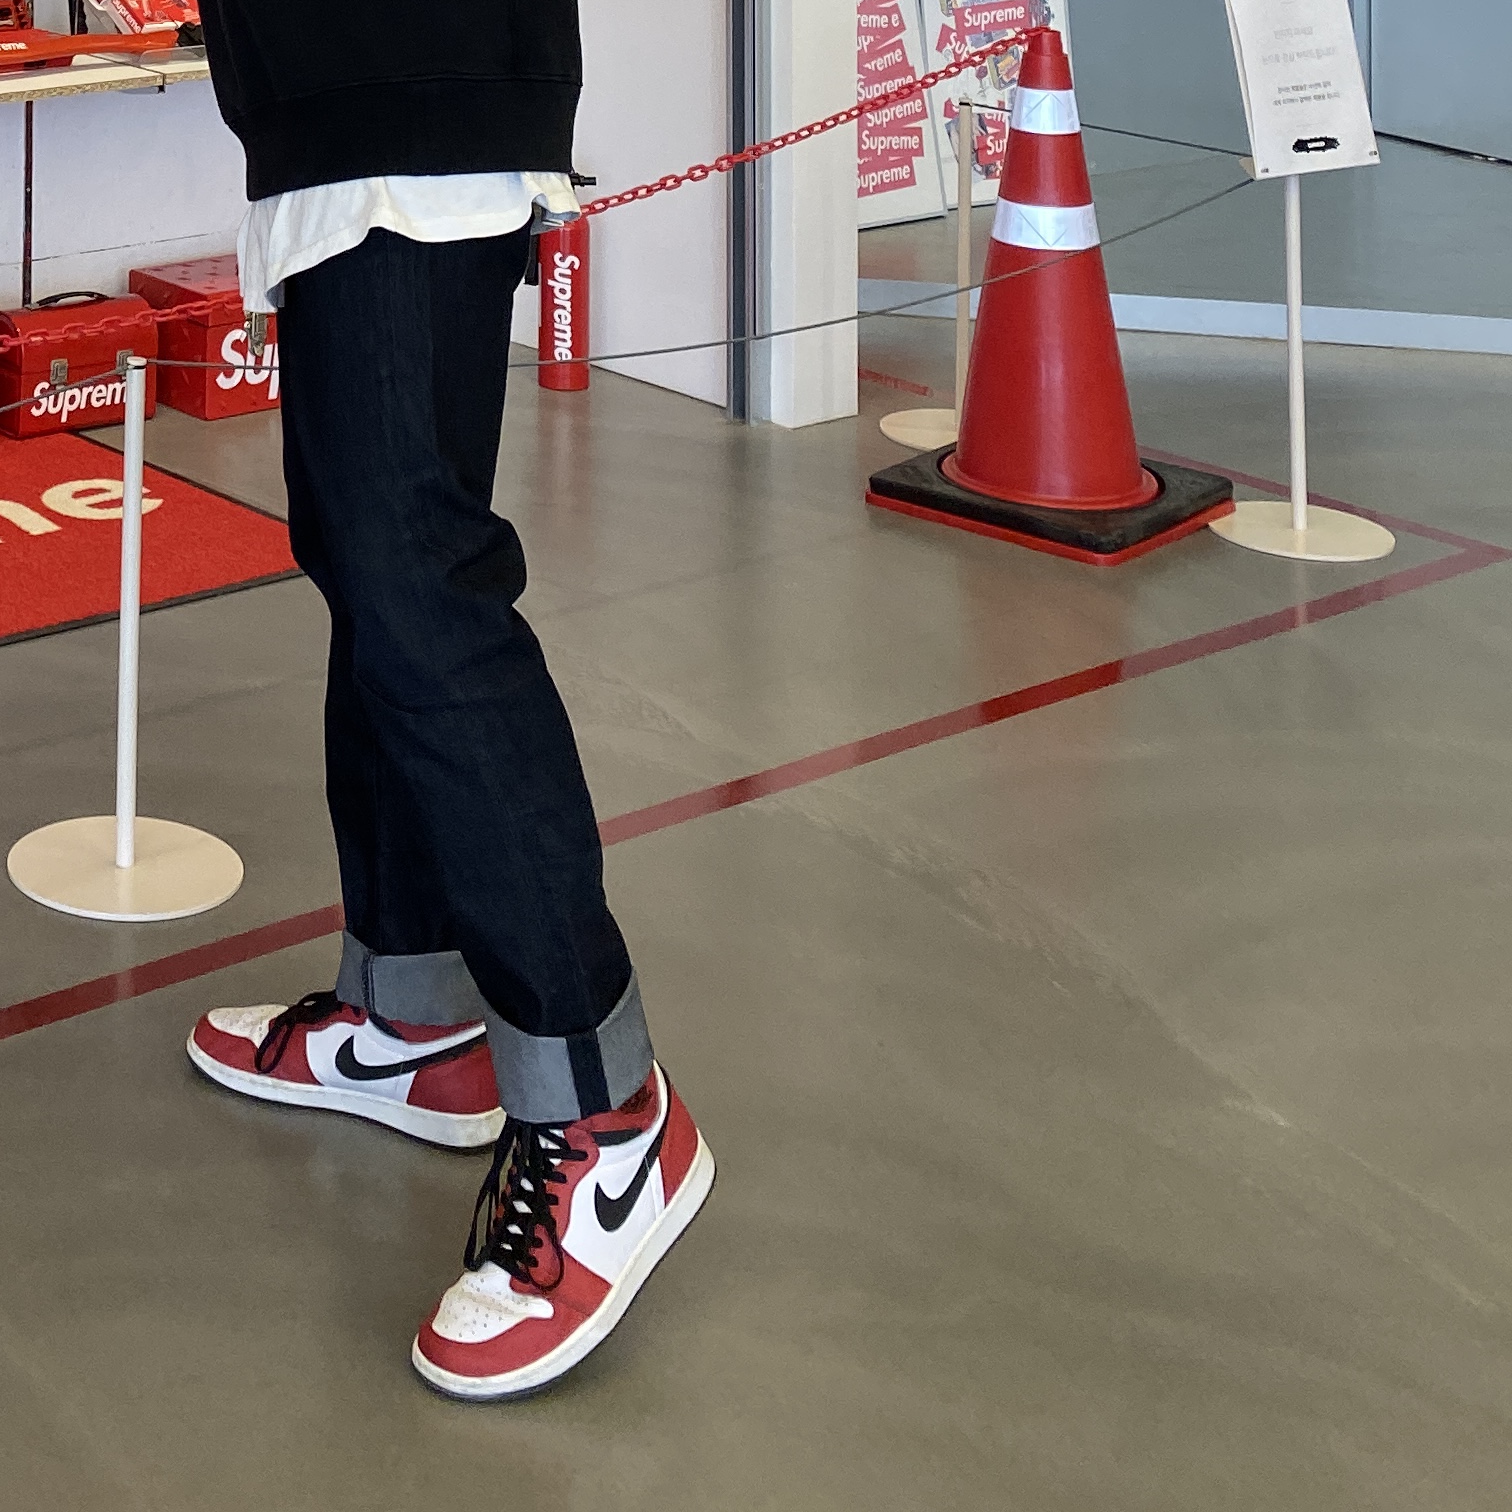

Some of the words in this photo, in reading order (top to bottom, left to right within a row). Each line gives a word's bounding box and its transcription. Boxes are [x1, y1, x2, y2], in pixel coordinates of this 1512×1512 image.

[964, 5, 1025, 31] Supreme
[861, 129, 920, 156] Supreme
[856, 164, 911, 193] upreme
[547, 251, 581, 361] Supreme
[30, 381, 127, 423] Suprem
